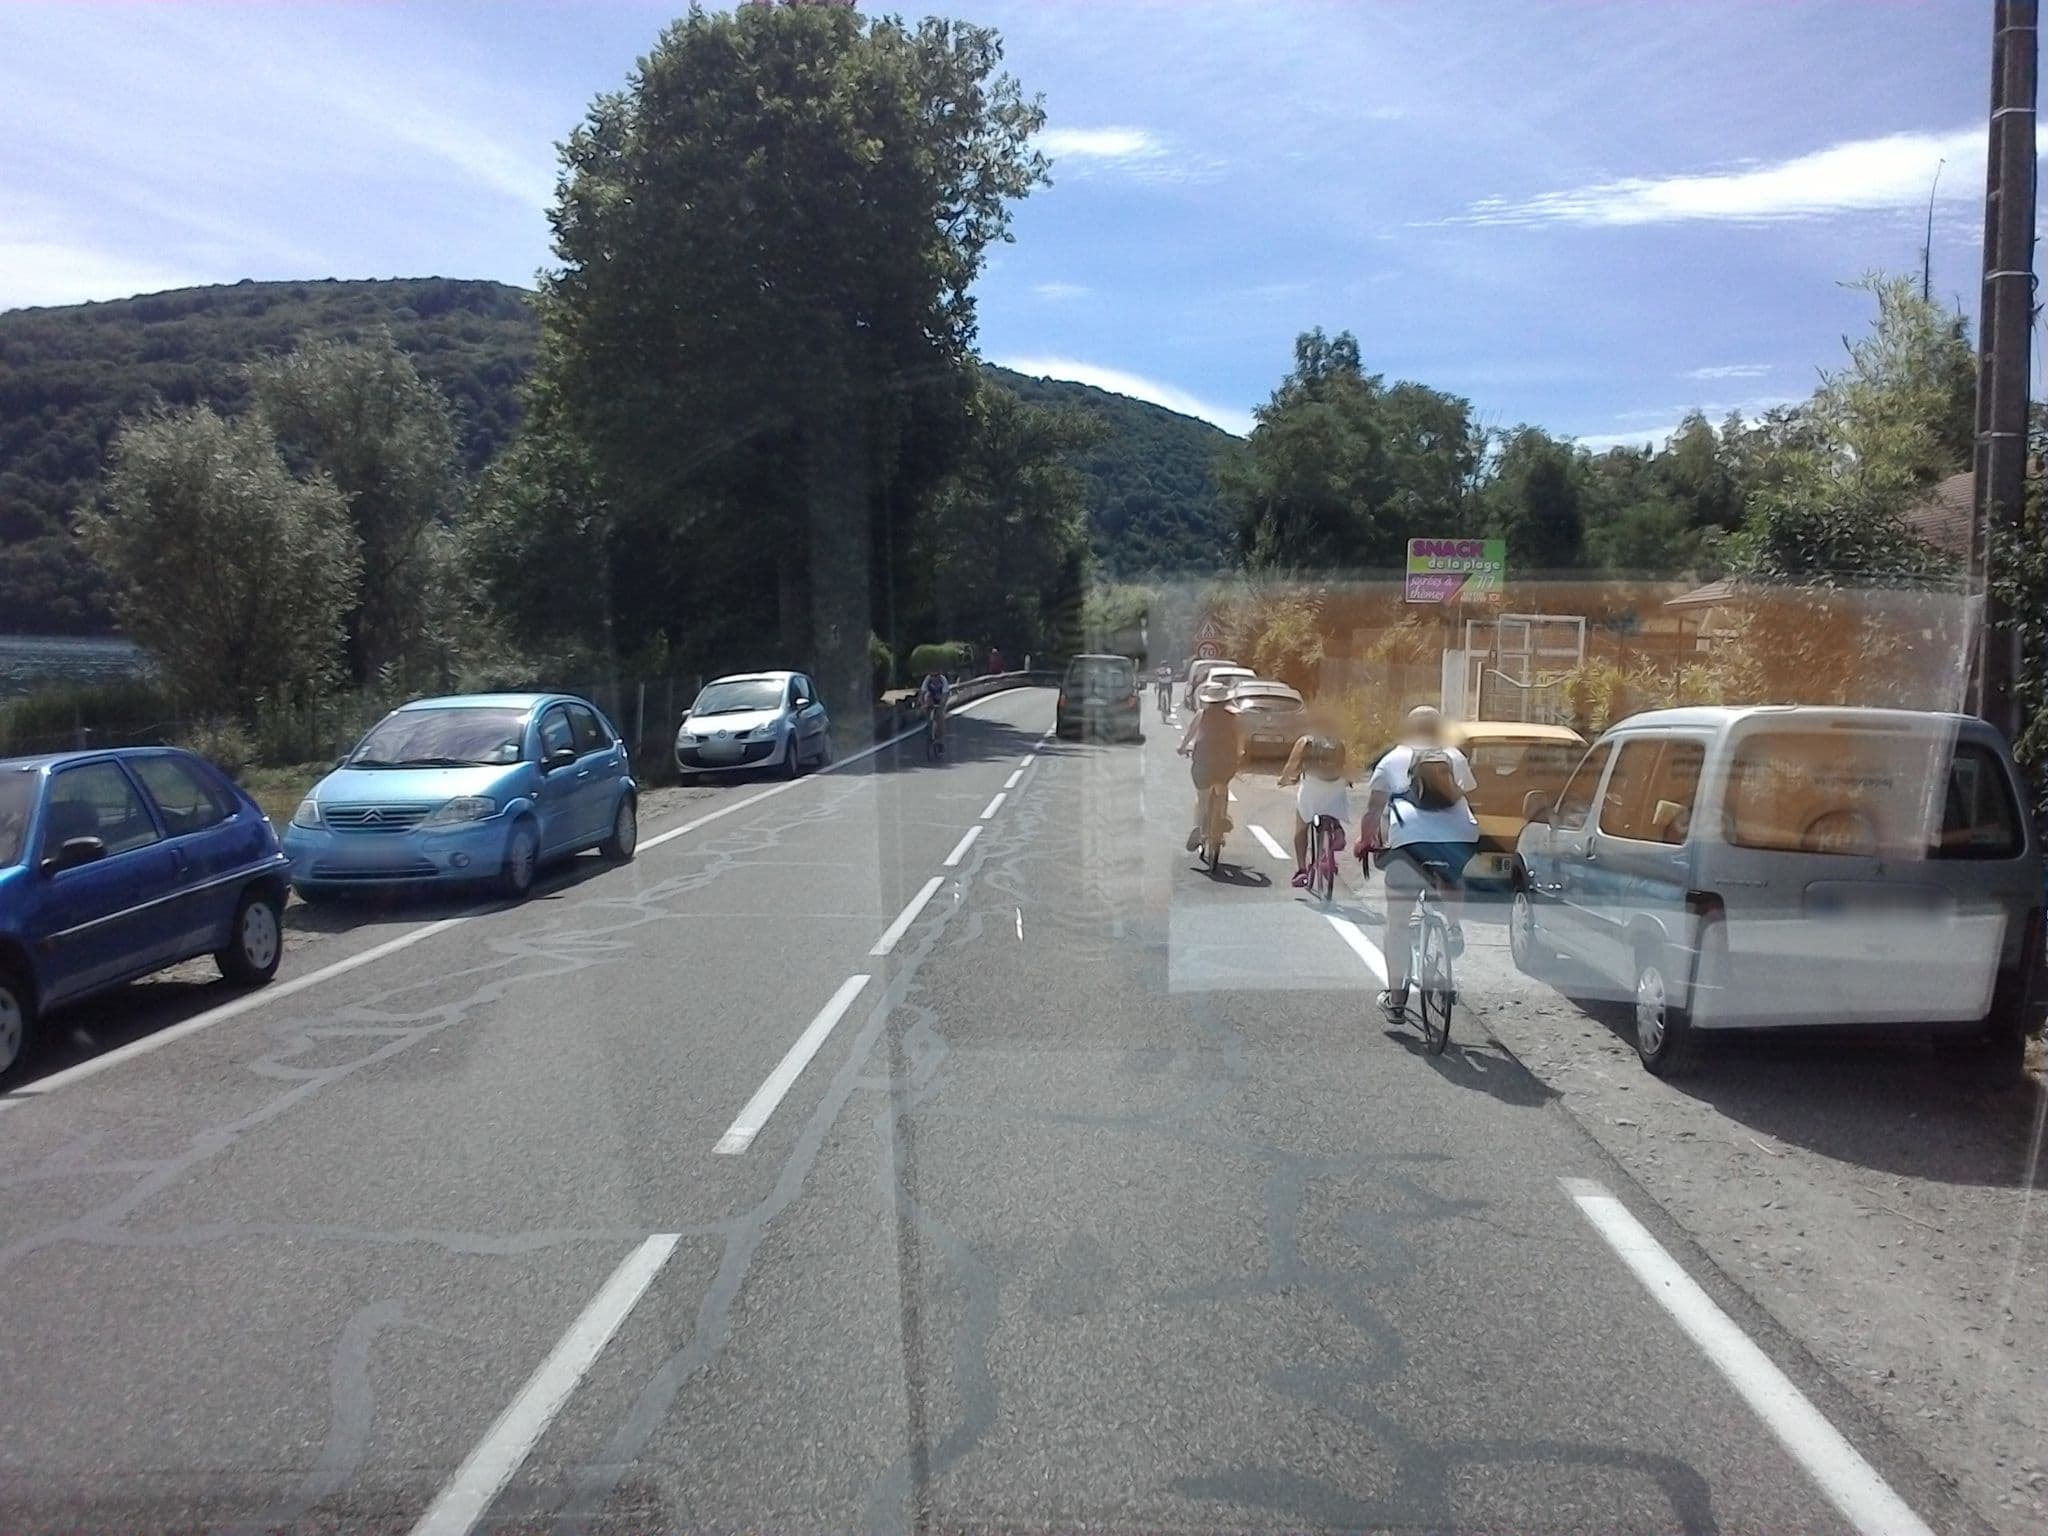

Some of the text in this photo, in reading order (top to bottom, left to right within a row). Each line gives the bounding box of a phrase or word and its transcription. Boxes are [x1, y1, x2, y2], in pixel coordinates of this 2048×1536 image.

[1413, 540, 1484, 557] SNACK
[1428, 559, 1501, 573] de la plage
[1202, 647, 1215, 656] 70
